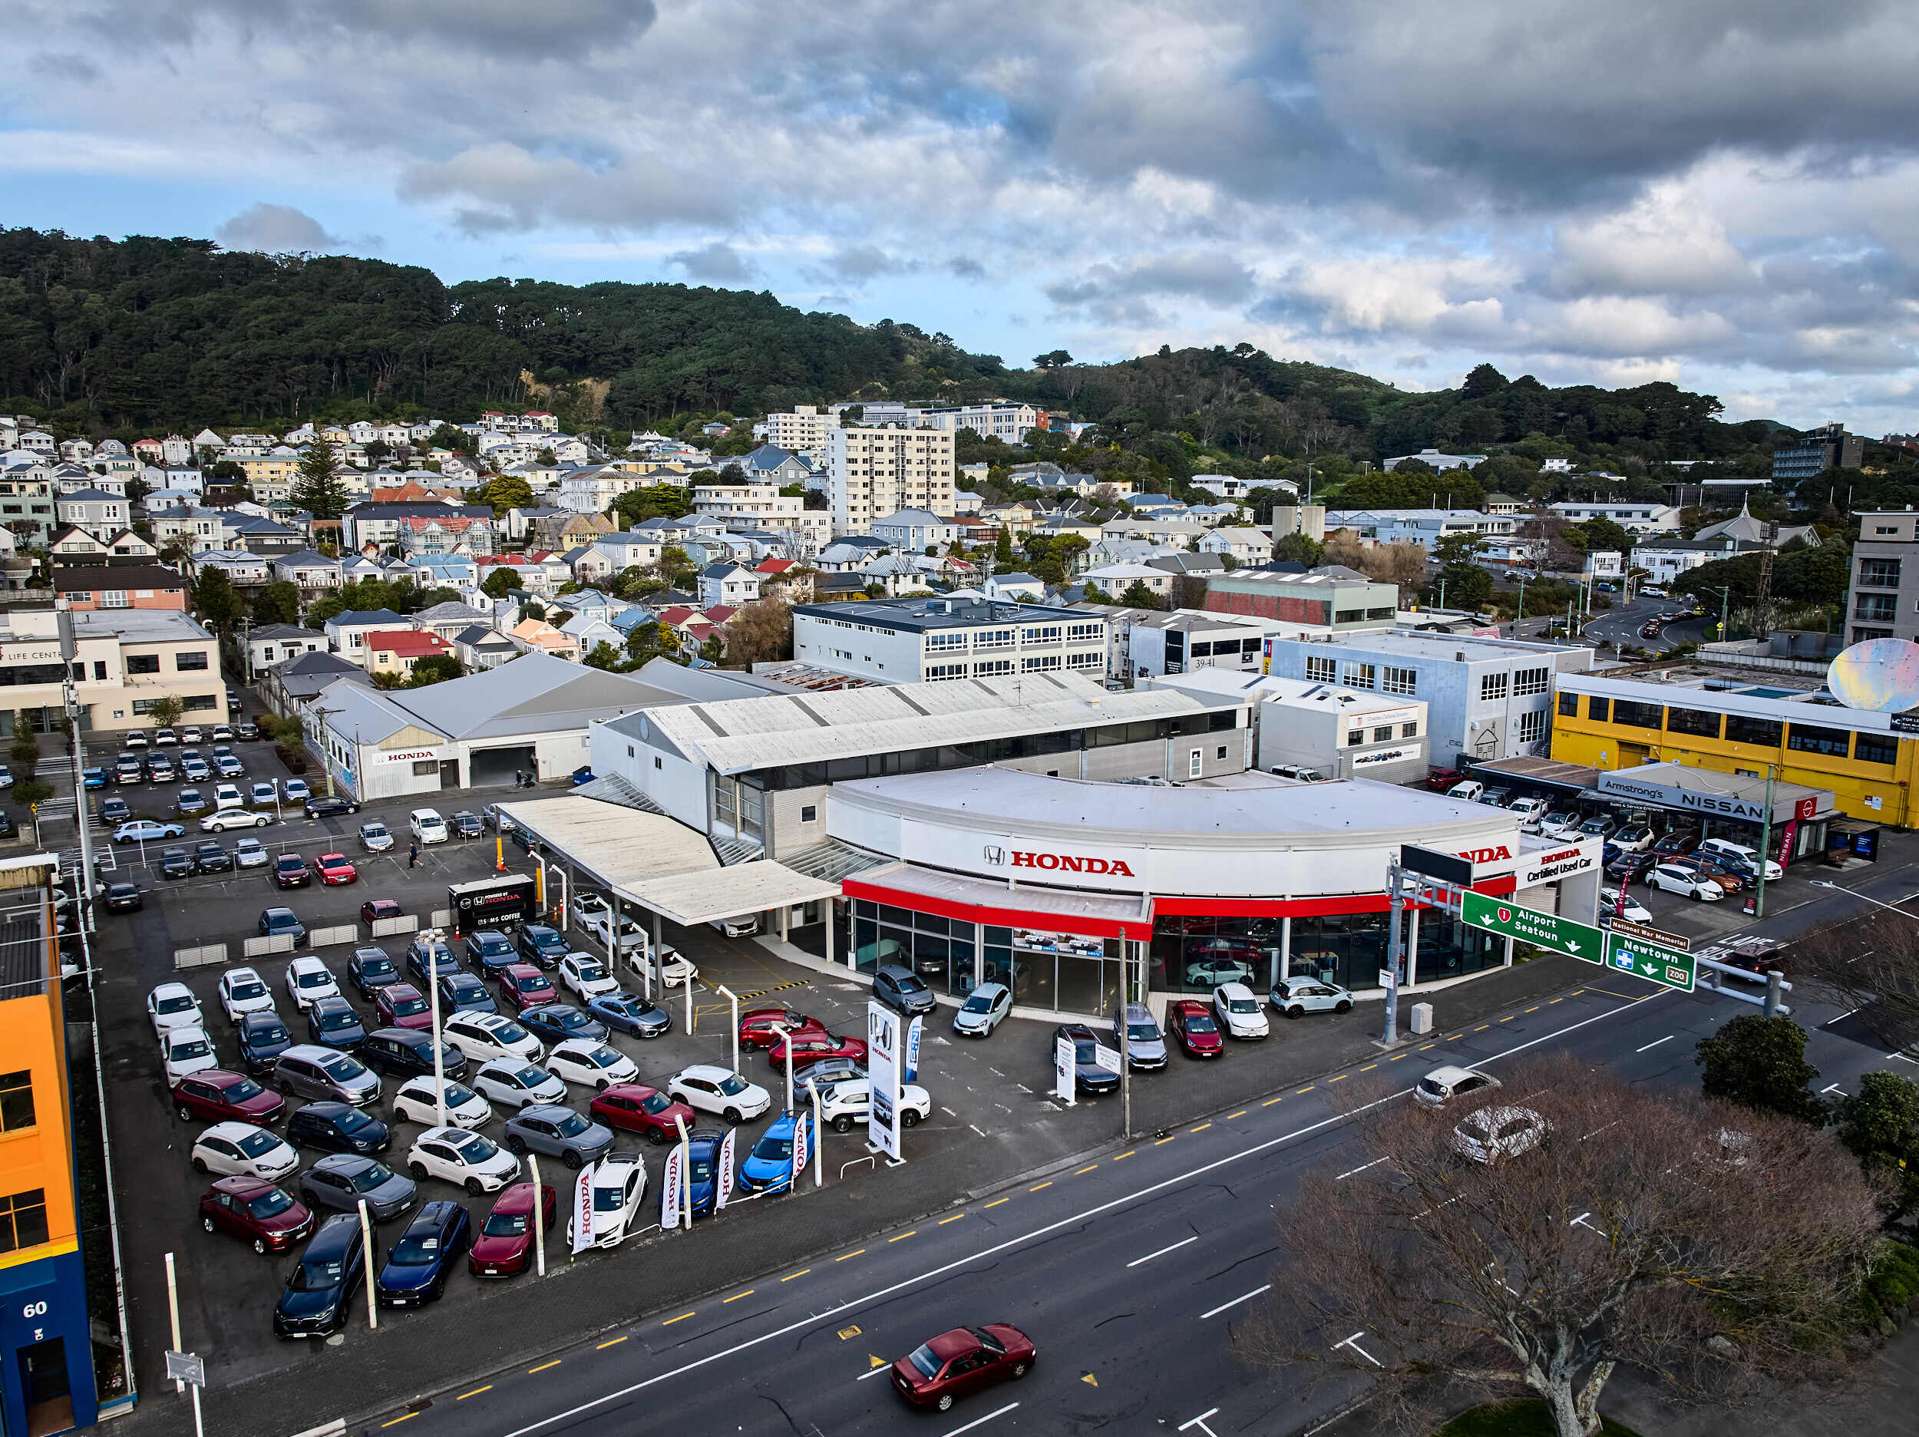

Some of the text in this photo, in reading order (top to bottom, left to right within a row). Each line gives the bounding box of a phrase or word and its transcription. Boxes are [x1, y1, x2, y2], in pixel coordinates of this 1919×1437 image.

[8, 652, 28, 660] LIFE
[1196, 658, 1215, 669] 39-41
[388, 751, 434, 761] HONDA
[1605, 780, 1664, 800] Armstrong's
[1681, 793, 1764, 819] NISSAN
[1458, 845, 1512, 864] NDA
[1540, 848, 1582, 865] HONDA
[1779, 832, 1792, 862] NISSAN
[1011, 851, 1136, 877] HONDA
[1527, 858, 1592, 882] Certified Used Car
[485, 894, 521, 904] HONDA
[500, 912, 521, 921] COFFEE
[1517, 909, 1558, 929] Airport
[1514, 921, 1559, 942] Seatoun
[1612, 921, 1687, 947] National War Memorial
[1623, 939, 1679, 964] Newtown
[1669, 969, 1685, 981] ZOO
[872, 1046, 892, 1063] HONDA
[722, 1138, 731, 1197] HONDA
[668, 1152, 679, 1212] HONDA
[581, 1173, 591, 1235] HONDA
[23, 1301, 48, 1318] 60
